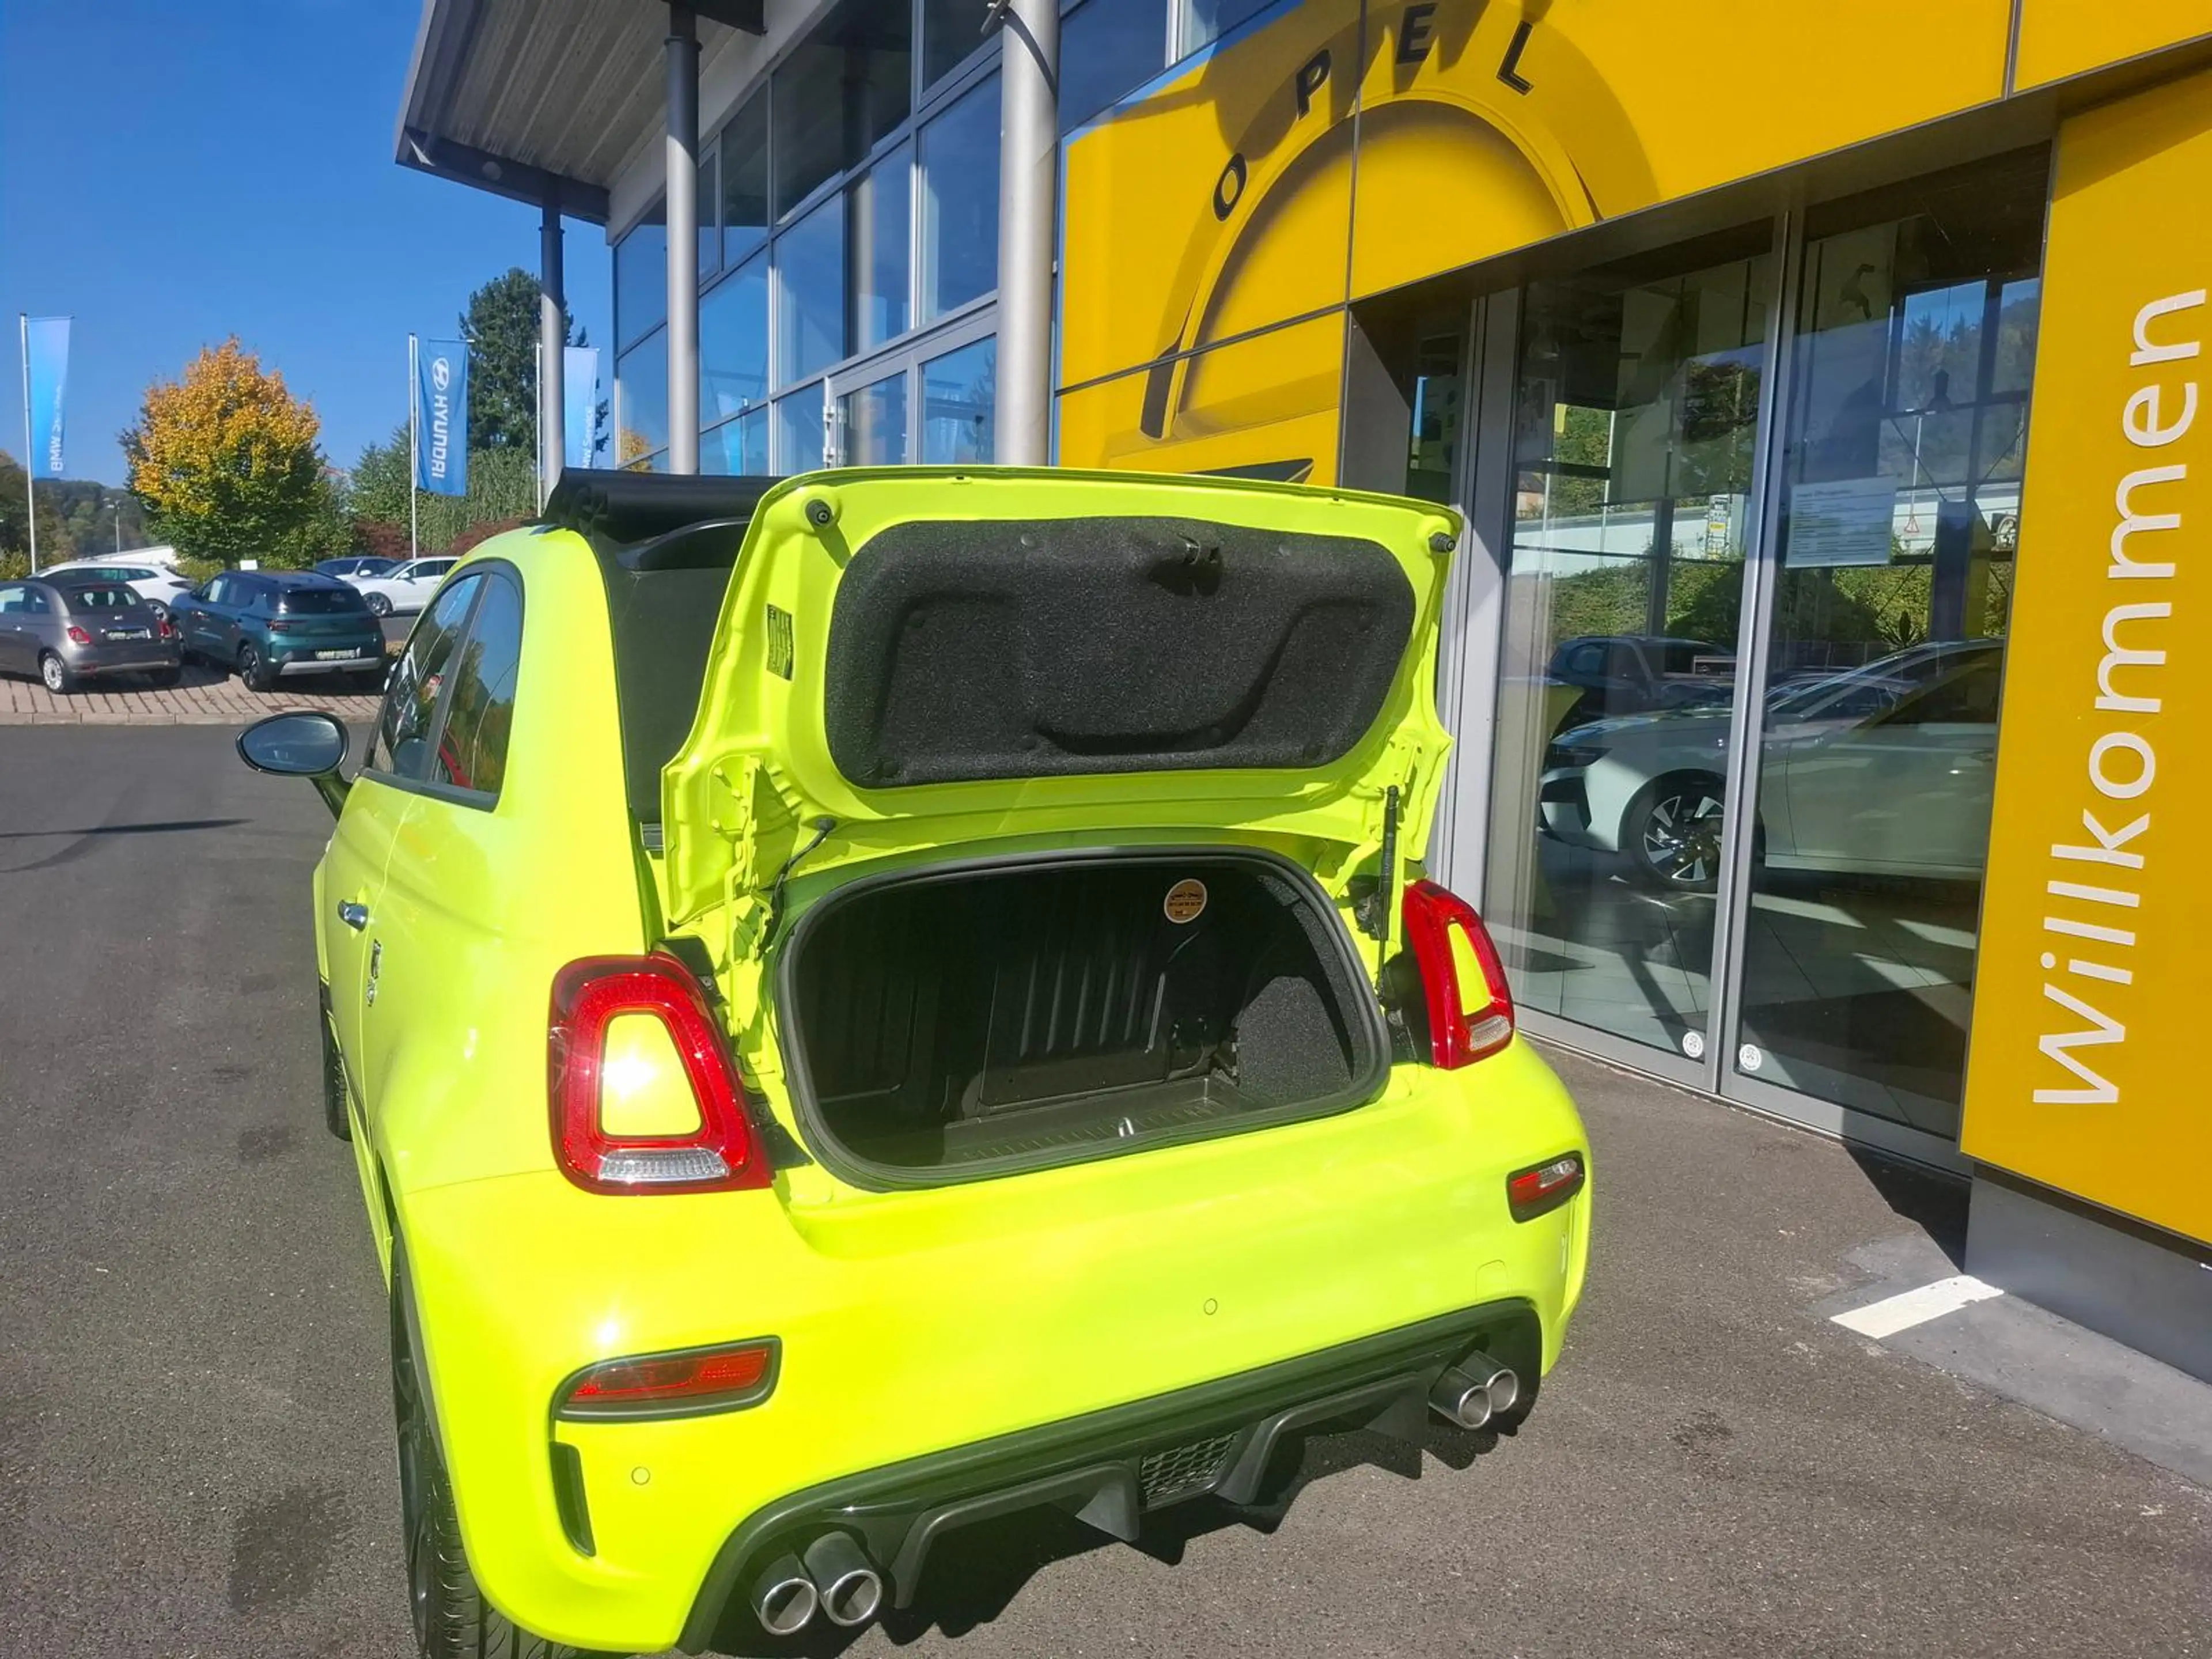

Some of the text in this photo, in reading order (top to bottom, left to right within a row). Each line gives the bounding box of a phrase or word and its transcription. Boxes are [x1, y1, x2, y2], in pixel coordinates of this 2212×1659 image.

[1213, 3, 1534, 222] OPEL
[50, 435, 63, 471] BMW
[431, 394, 448, 479] HYUNDAI
[2033, 289, 2207, 1104] Willkommen
